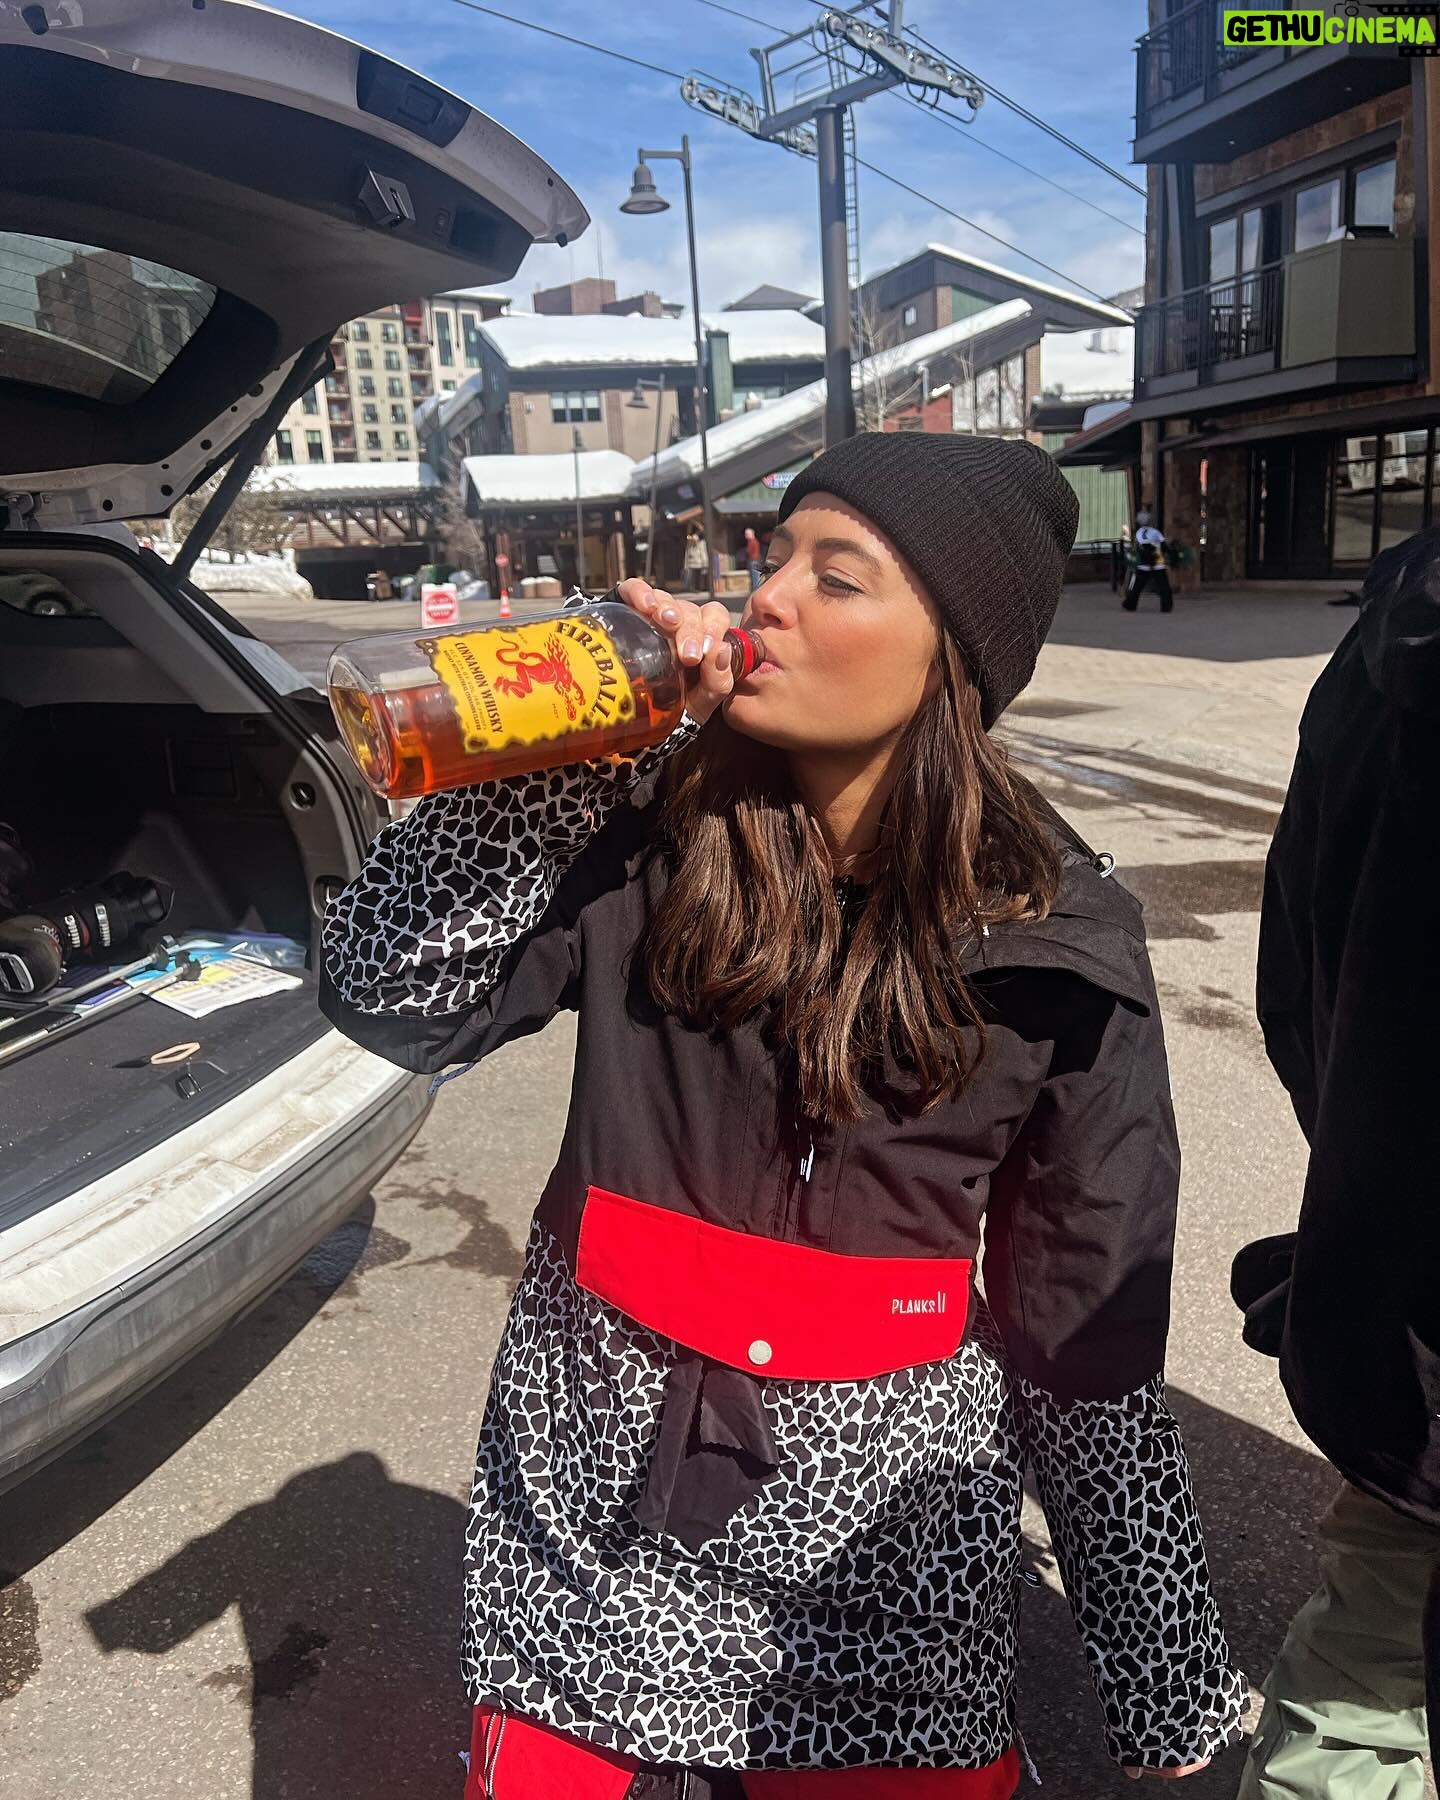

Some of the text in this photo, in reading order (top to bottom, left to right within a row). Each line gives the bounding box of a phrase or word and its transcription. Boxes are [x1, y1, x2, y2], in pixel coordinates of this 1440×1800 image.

[455, 642, 489, 687] CINNAMON
[481, 689, 503, 733] WHISKY
[556, 621, 618, 718] FIREBALL
